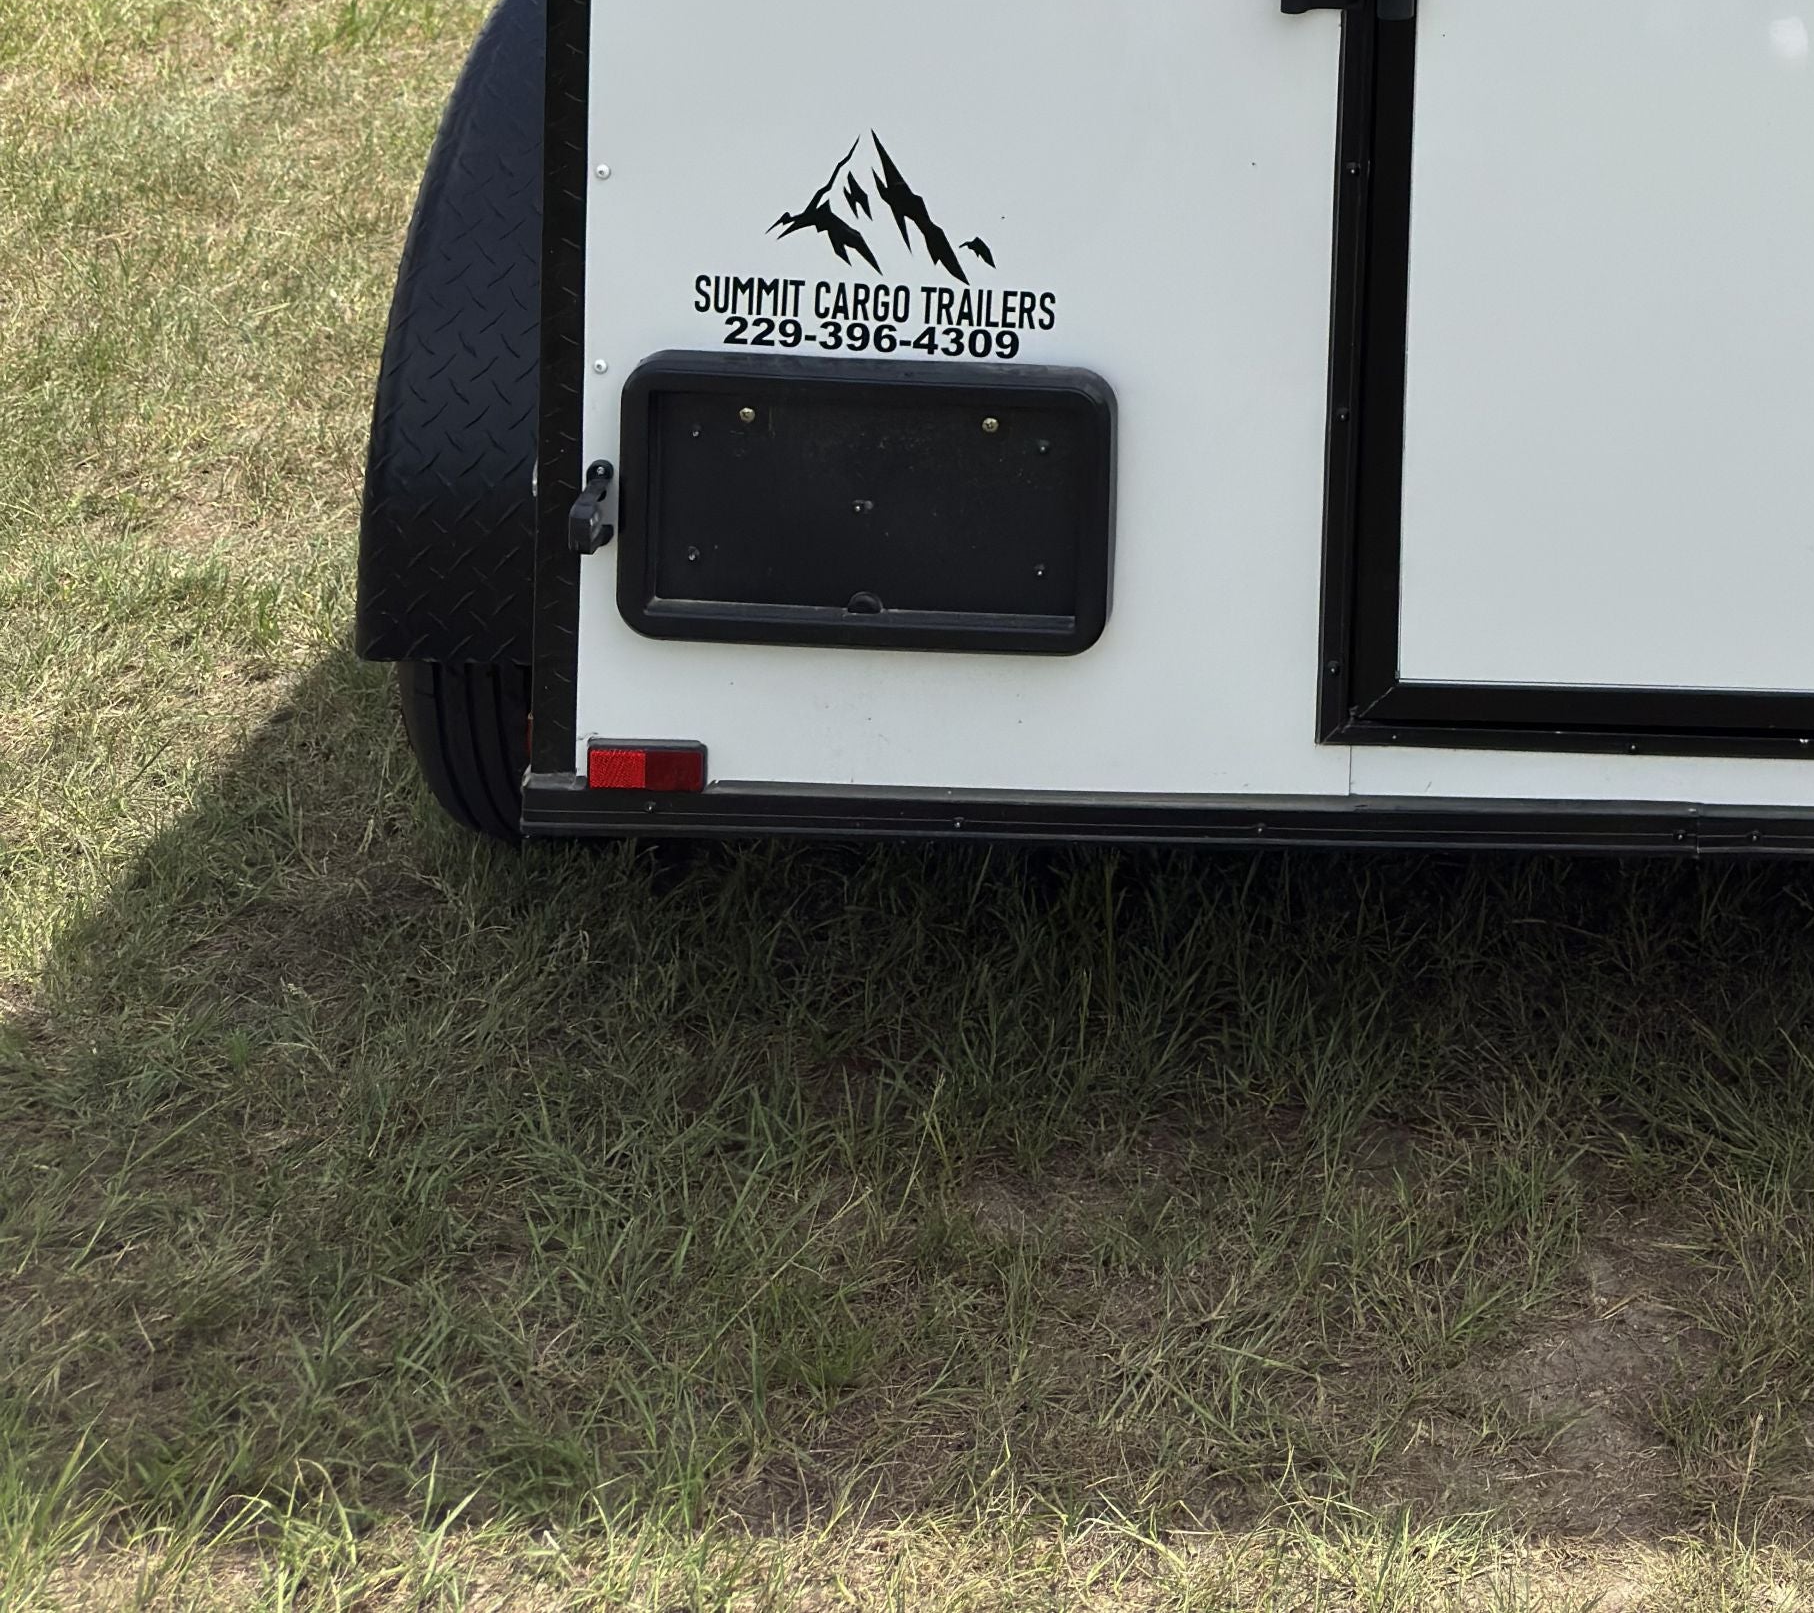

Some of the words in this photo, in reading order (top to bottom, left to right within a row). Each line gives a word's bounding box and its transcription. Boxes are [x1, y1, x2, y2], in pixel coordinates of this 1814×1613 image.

[694, 274, 806, 318] SUMMIT
[814, 281, 911, 324] CARGO
[920, 286, 1057, 331] TRAILERS
[722, 315, 1021, 360] 229-396-4309
